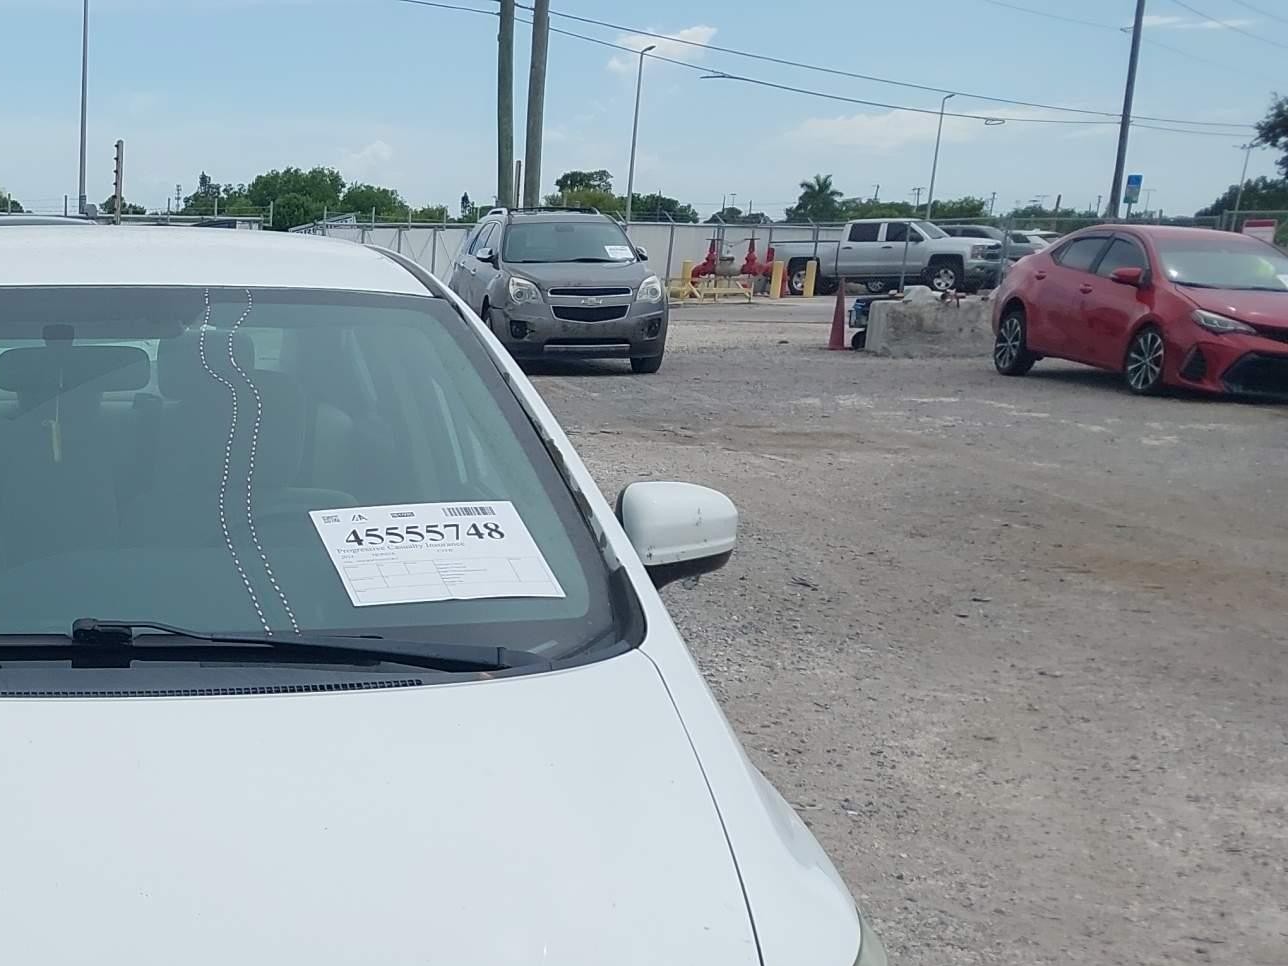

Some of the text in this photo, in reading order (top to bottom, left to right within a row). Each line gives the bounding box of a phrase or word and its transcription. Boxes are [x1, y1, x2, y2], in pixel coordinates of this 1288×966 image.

[345, 522, 505, 546] 45555748
[336, 546, 386, 555] Progressive
[387, 543, 423, 551] Casualty
[424, 541, 465, 549] Insurance
